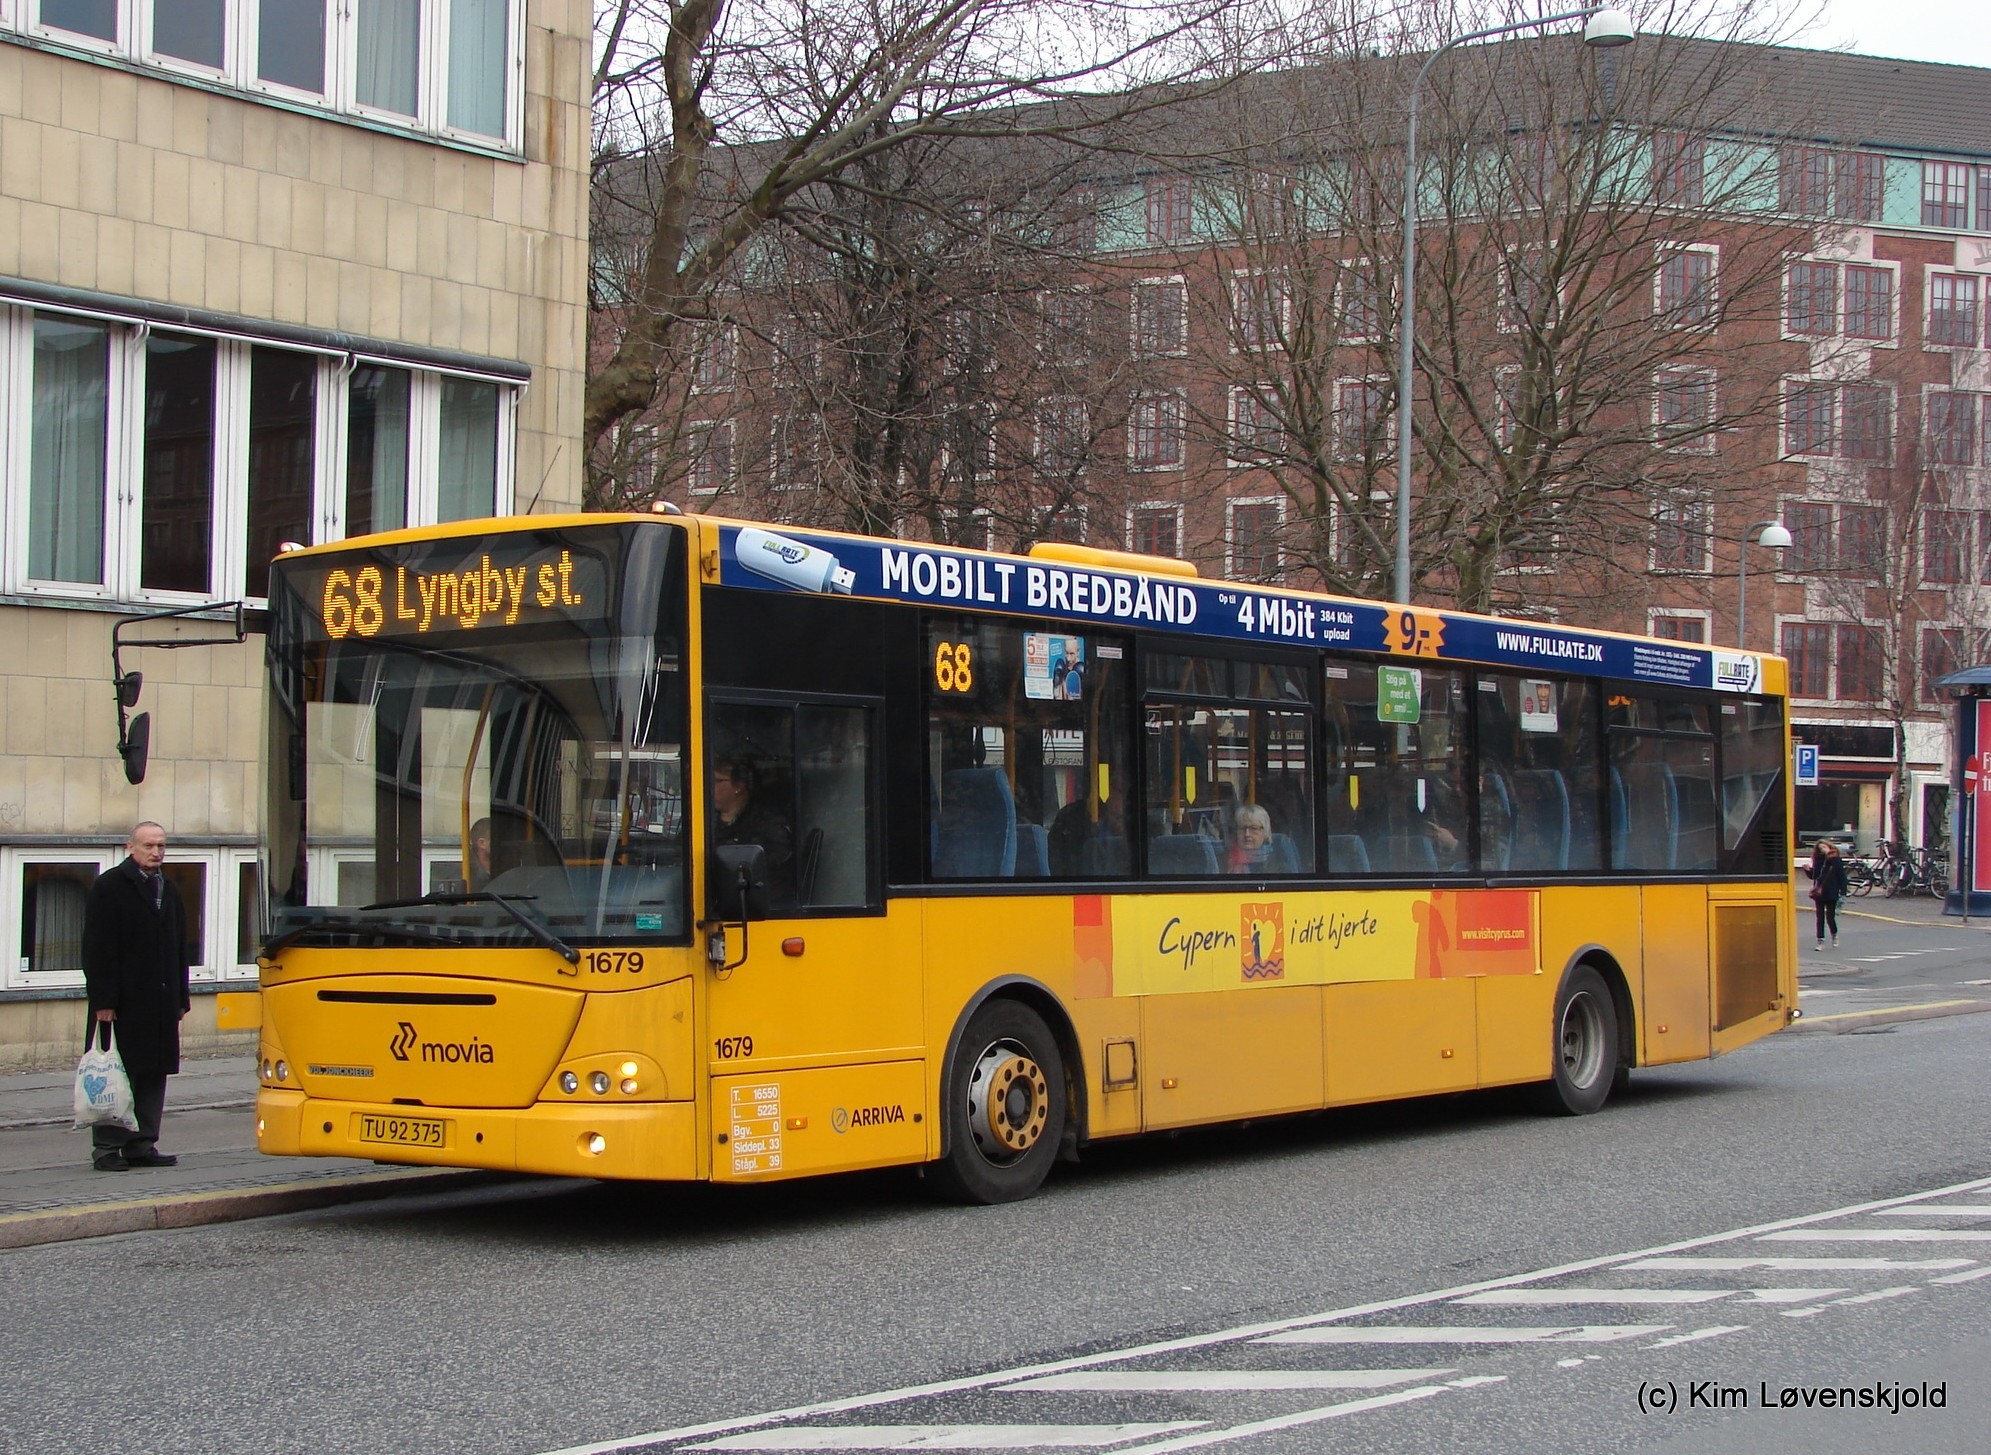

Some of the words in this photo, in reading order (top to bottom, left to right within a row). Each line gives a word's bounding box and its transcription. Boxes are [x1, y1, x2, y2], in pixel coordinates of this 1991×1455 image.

[322, 566, 383, 639] 68
[396, 555, 527, 632] Lyngby
[536, 550, 582, 608] st.
[881, 548, 1016, 604] MOBILT
[1027, 567, 1198, 625] BREDBÅND
[1218, 593, 1229, 605] Op
[1229, 594, 1237, 605] til
[1320, 610, 1336, 624] 384
[1337, 611, 1354, 625] Kbit
[1323, 628, 1350, 641] upload
[1496, 631, 1603, 662] WWW.FULLRATE.DK
[935, 641, 972, 692] 68
[1719, 661, 1750, 679] FULLRATE
[1802, 750, 1812, 765] P
[1158, 917, 1236, 970] Cypern
[1290, 919, 1298, 945] i
[1299, 915, 1325, 944] dit
[1329, 909, 1377, 950] hjerte
[1461, 928, 1525, 942] www.visitcyprus.com
[585, 951, 644, 974] 1679
[422, 1036, 494, 1064] movia
[714, 1036, 753, 1059] 1679
[733, 1089, 741, 1102] T.
[753, 1087, 778, 1099] 16550
[733, 1107, 741, 1119] L.
[757, 1104, 778, 1116] 5225
[851, 1105, 904, 1128] ARRIVA
[364, 1118, 386, 1139] TU
[389, 1120, 408, 1141] 92
[411, 1122, 441, 1143] 375
[733, 1124, 752, 1138] Bgv.
[773, 1121, 779, 1133] 0
[734, 1140, 767, 1155] Siddepl.
[769, 1138, 780, 1150] 33
[735, 1157, 758, 1172] Ståpl.
[769, 1155, 780, 1167] 39
